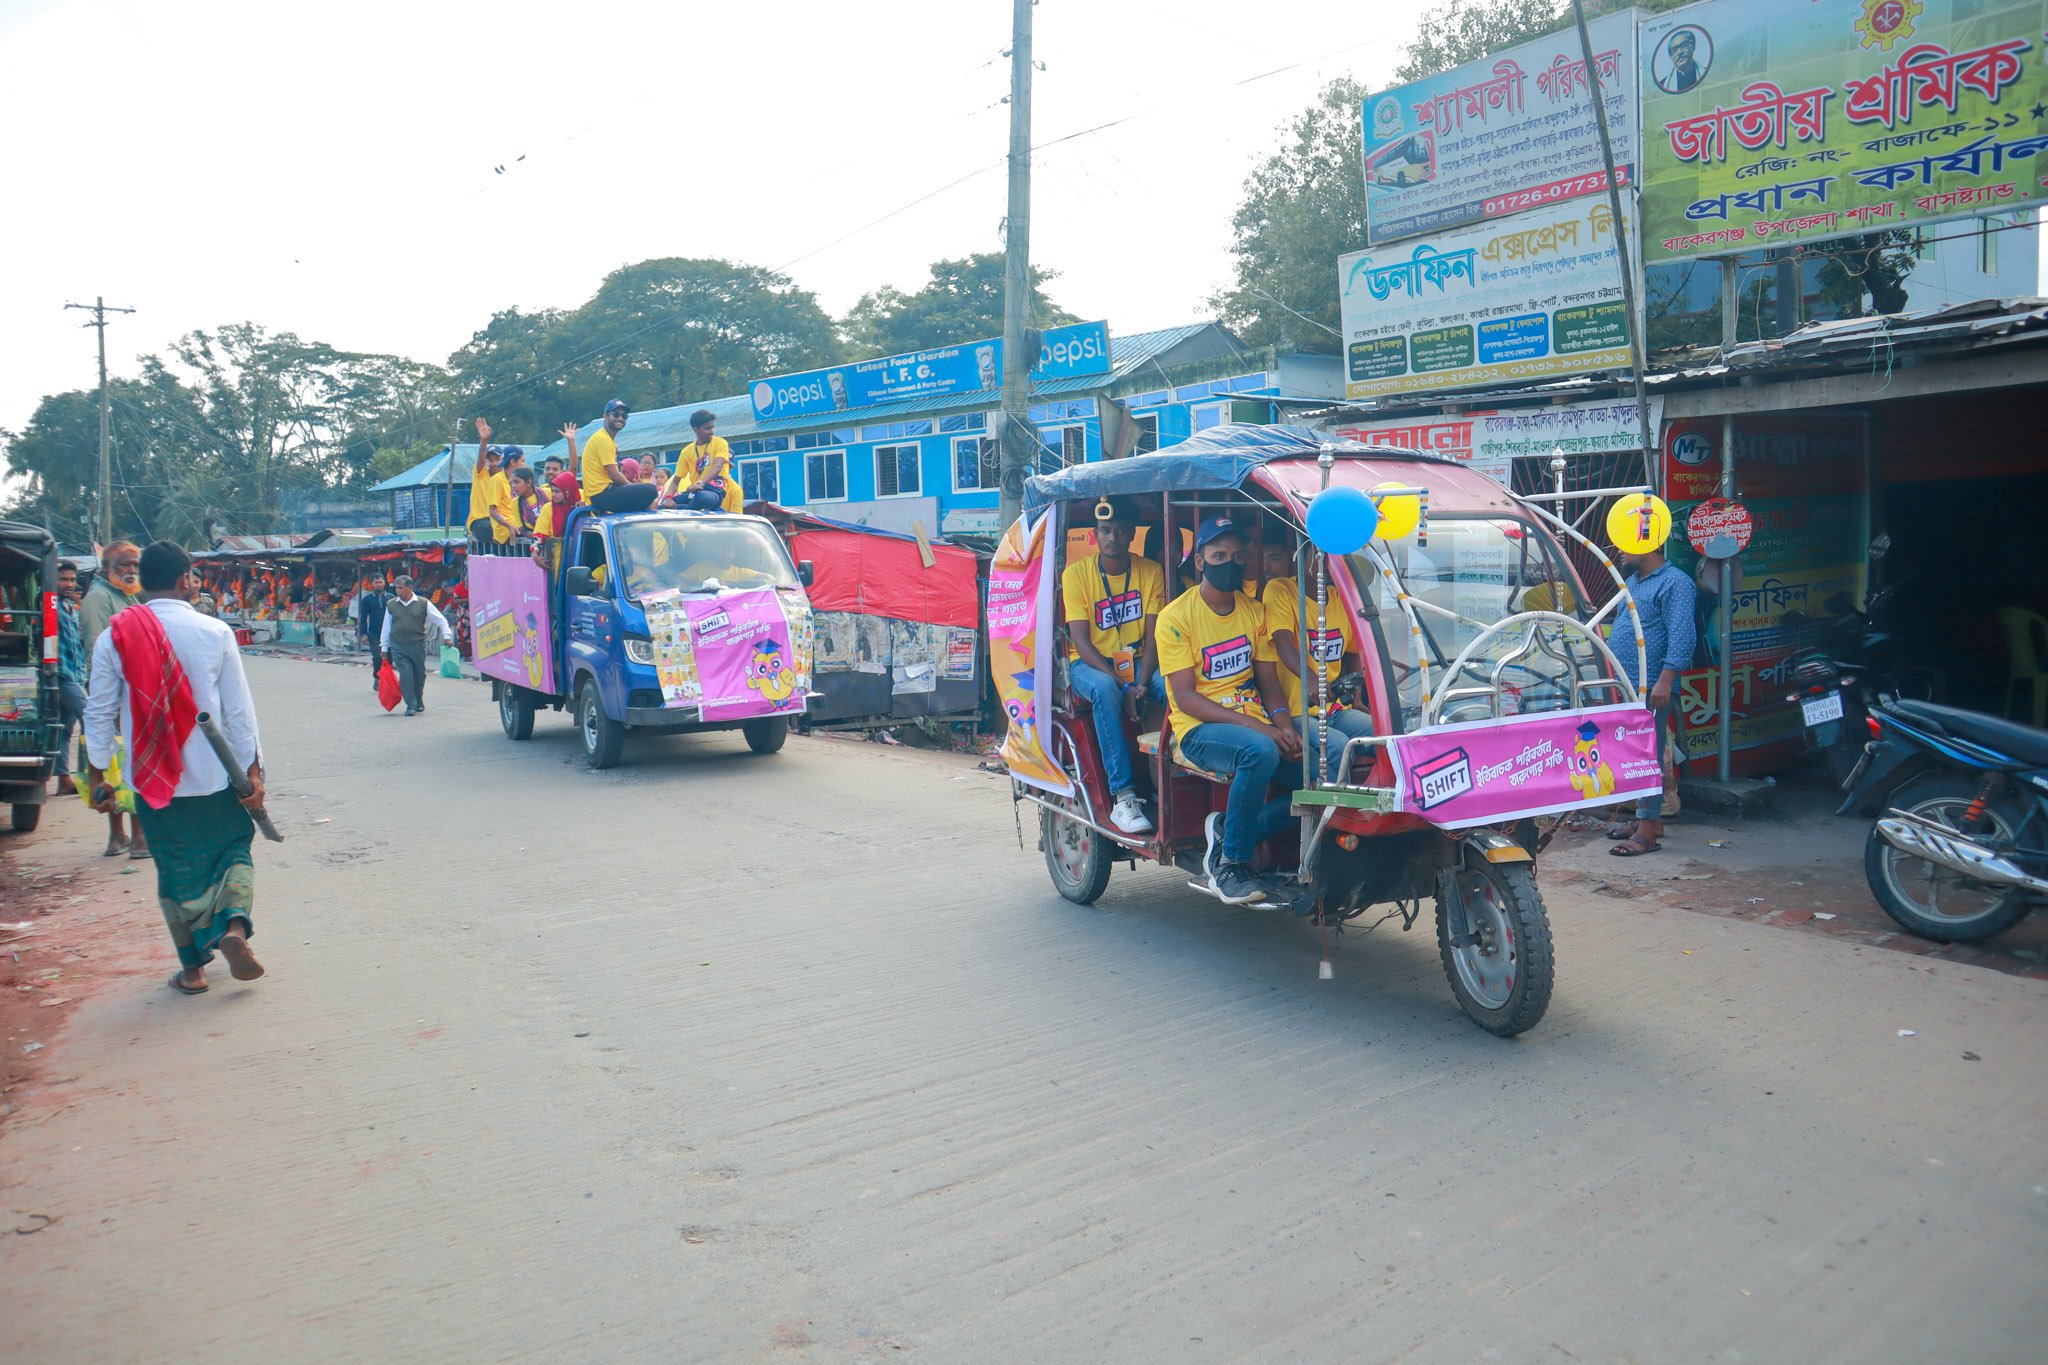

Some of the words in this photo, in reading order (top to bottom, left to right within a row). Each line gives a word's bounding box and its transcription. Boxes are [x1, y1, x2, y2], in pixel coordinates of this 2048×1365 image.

[1410, 58, 1528, 137] শ্যামলী
[1664, 81, 1833, 163] জাতীয়
[1844, 43, 2030, 126] শ্রমিক
[1485, 170, 1627, 216] 01726-077379
[1684, 177, 1838, 221] প্রধান
[1850, 134, 2048, 186] কার্যাল
[1660, 226, 1745, 253] বাকেরগঞ্জ
[1752, 211, 1836, 238] উপজেলা
[1362, 243, 1480, 301] ডলফিন
[1480, 218, 1582, 263] এক্সপ্রেস
[855, 360, 889, 374] Latest
[890, 354, 916, 368] Food
[917, 348, 960, 363] Garden
[1037, 329, 1104, 373] pepsi
[882, 370, 896, 385] L.
[900, 367, 913, 382] F.
[916, 363, 937, 379] G.
[776, 377, 827, 414] pepsi
[701, 614, 727, 631] SHIFT
[1213, 652, 1252, 676] SHIFT
[1807, 707, 1841, 724] 13-5190
[1424, 767, 1466, 800] SHIFT
[1474, 756, 1514, 788] ইতিবাচক
[1516, 738, 1553, 767] পরিবর্তনে
[1508, 765, 1544, 788] তারুণ্যের
[1545, 747, 1565, 769] শক্তি
